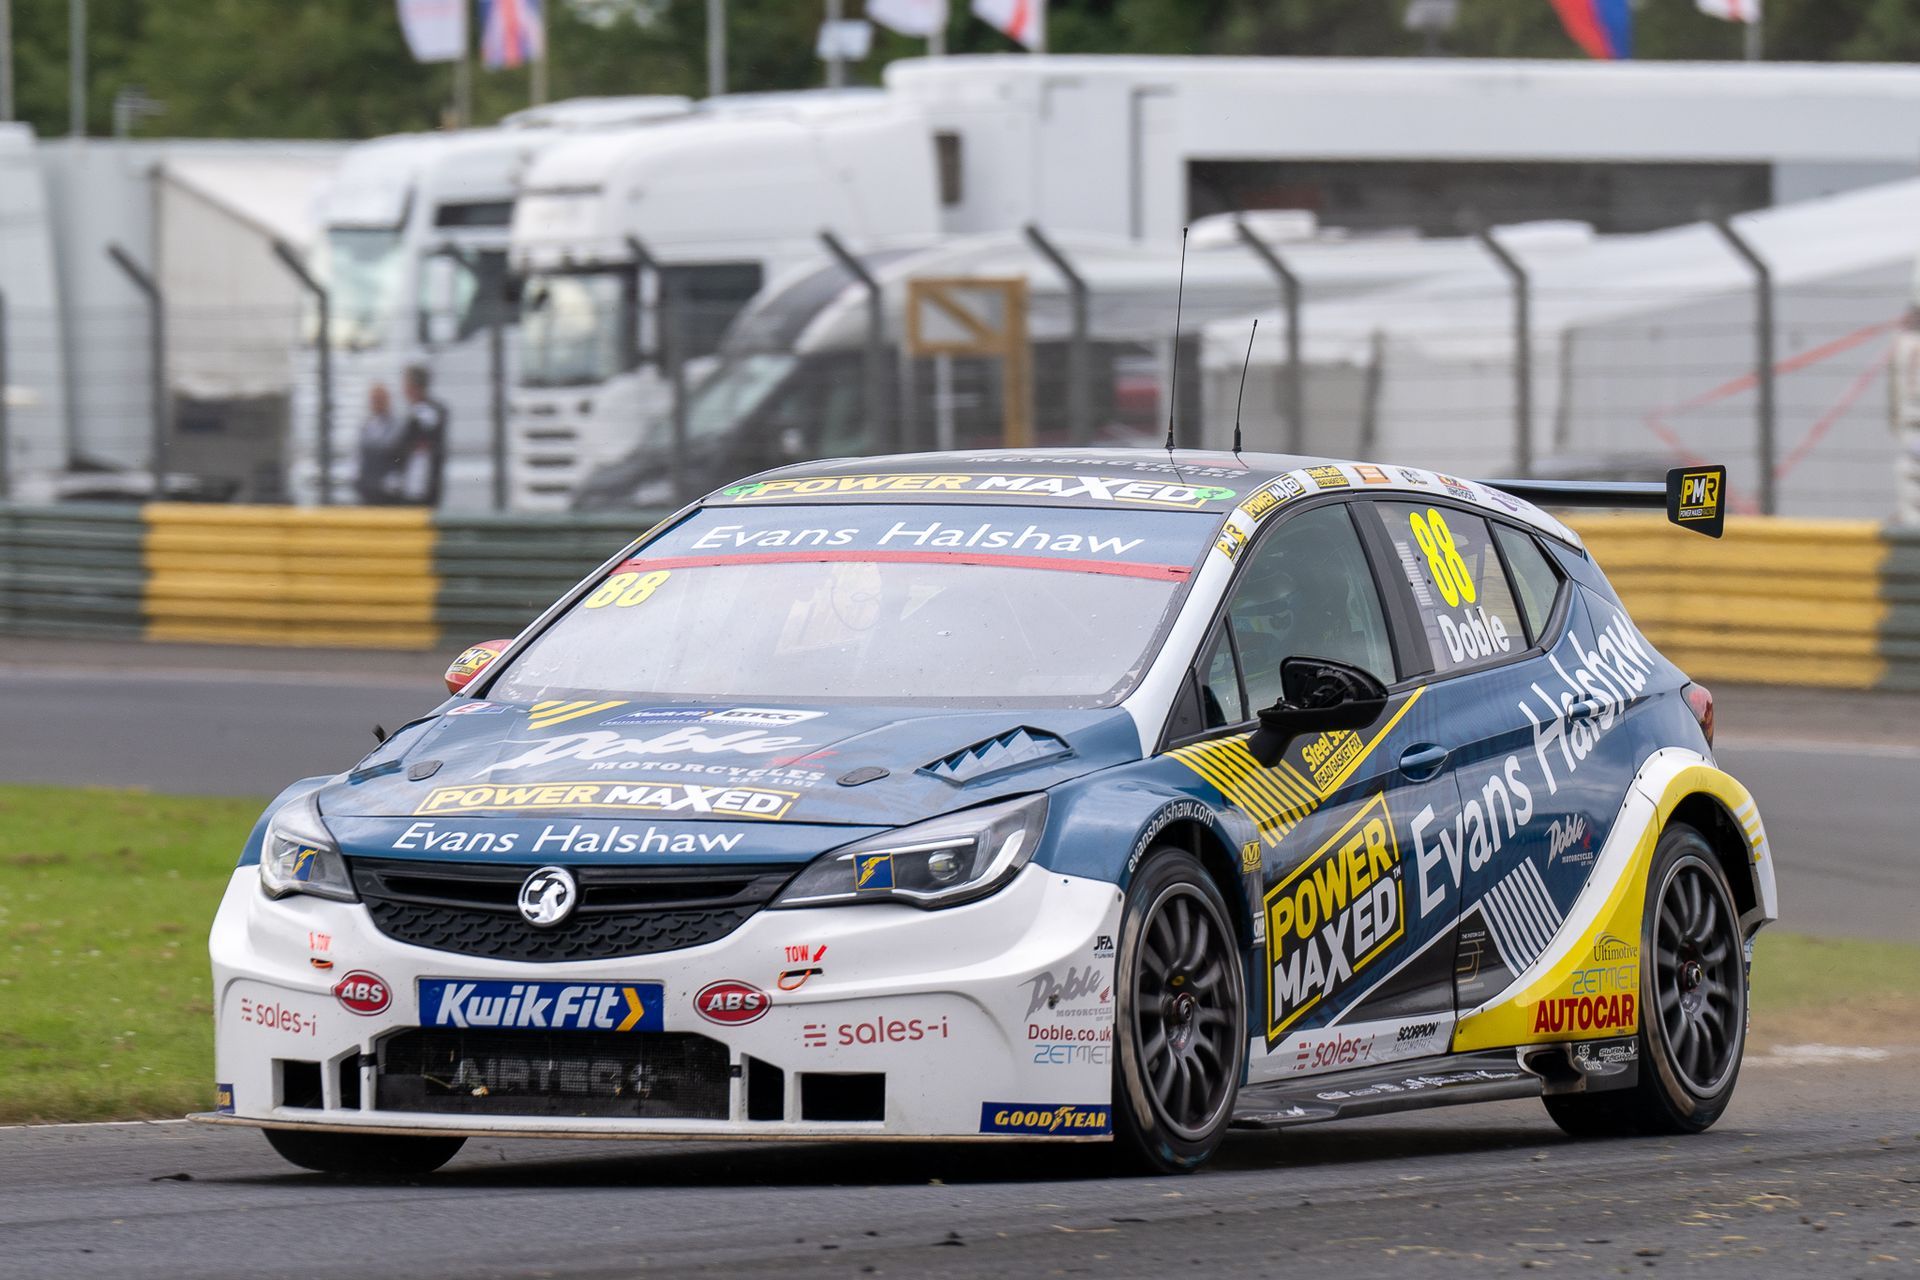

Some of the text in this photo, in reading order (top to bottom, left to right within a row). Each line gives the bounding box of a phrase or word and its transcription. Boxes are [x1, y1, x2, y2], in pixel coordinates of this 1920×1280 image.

[752, 475, 1200, 500] POWER MAXED
[1244, 477, 1301, 516] POWER MAXED
[1682, 477, 1717, 504] PMR
[691, 521, 1146, 555] Evans Halshaw
[1216, 524, 1242, 557] PMR
[1409, 507, 1477, 608] 88
[583, 570, 672, 609] 88
[1436, 605, 1510, 663] Doble
[470, 726, 823, 778] Doble
[1301, 731, 1334, 772] Steel
[1410, 754, 1534, 919] Evans
[1518, 606, 1656, 796] Halshaw
[588, 760, 826, 781] MOTORCYCLES
[425, 783, 785, 814] POWER MAXED
[391, 821, 746, 854] Evans Halshaw
[1128, 800, 1214, 873] evanshalshaw.com
[1544, 813, 1587, 869] Doble
[1271, 817, 1393, 962] POWER
[785, 945, 810, 964] TOW
[1094, 936, 1114, 951] JFA
[1274, 876, 1397, 1022] MAXED
[1593, 944, 1638, 962] Ultimotive
[340, 979, 384, 1004] ABS
[706, 993, 763, 1012] ABS
[1017, 966, 1104, 1023] Doble
[256, 1002, 318, 1037] sales-i
[1533, 993, 1635, 1033] AUTOCAR
[838, 1015, 950, 1046] sales-i
[1028, 1024, 1112, 1042] Doble.co.uk
[1397, 1021, 1438, 1042] SCORPION
[1311, 1033, 1376, 1069] sales-i
